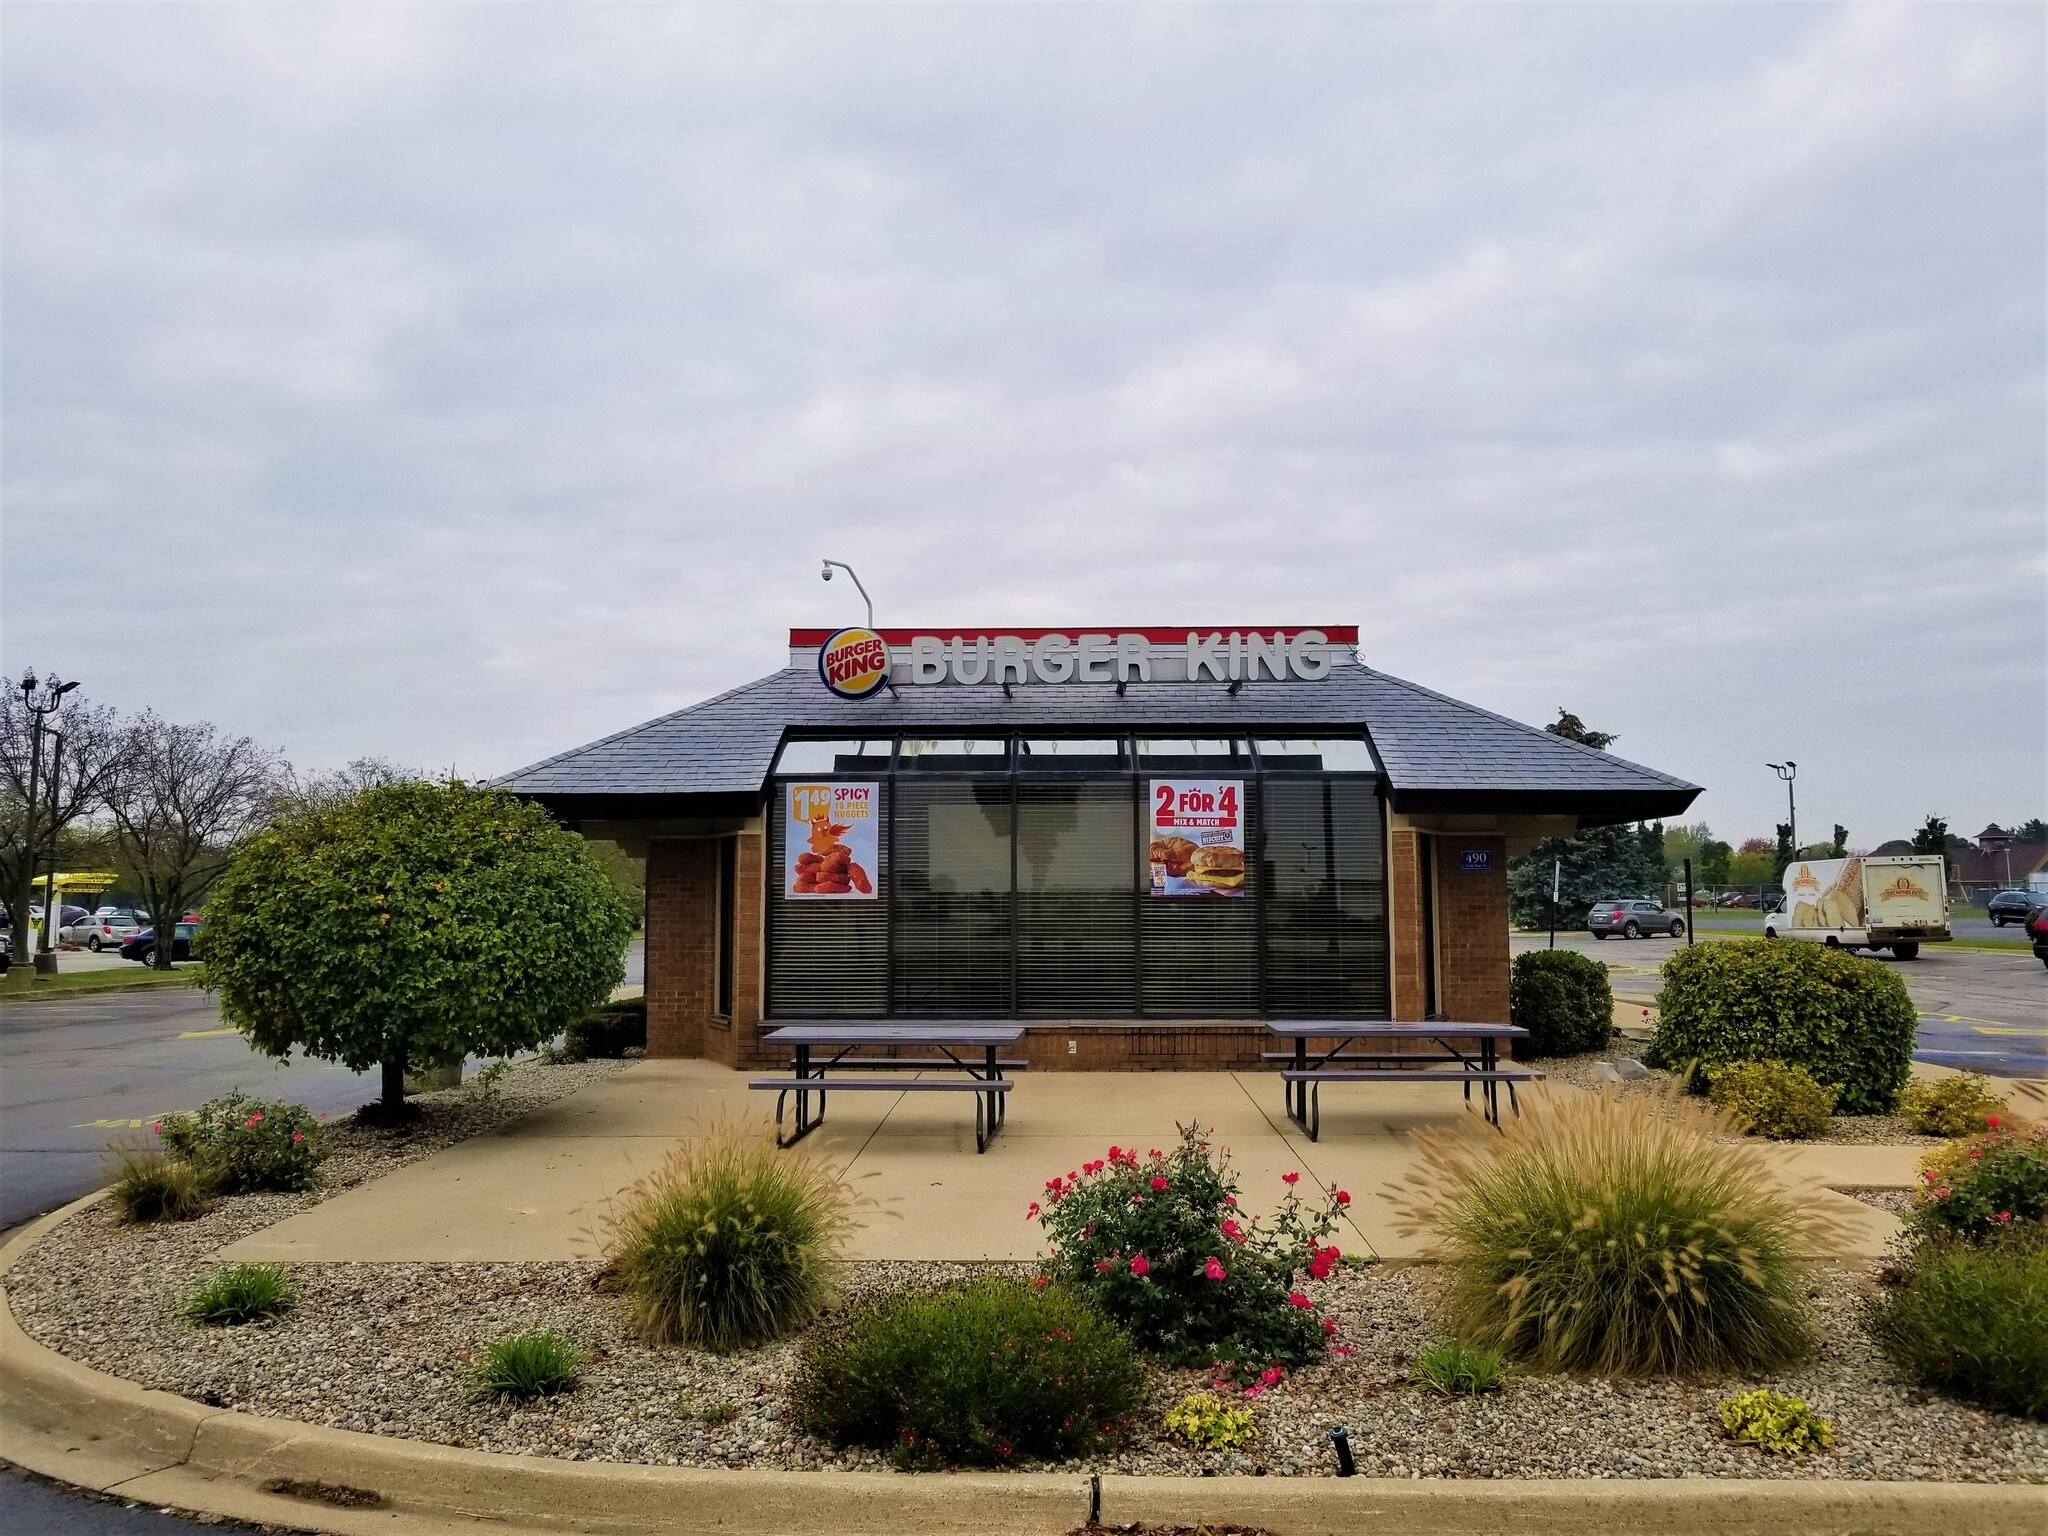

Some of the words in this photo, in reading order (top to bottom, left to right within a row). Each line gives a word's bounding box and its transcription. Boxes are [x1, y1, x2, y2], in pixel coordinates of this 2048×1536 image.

[826, 639, 883, 668] BURGER
[911, 633, 1152, 686] BURGER
[1185, 630, 1332, 683] KING
[829, 651, 886, 686] KING
[834, 788, 870, 801] SPICY
[1156, 785, 1175, 817] 2
[1179, 792, 1215, 812] FOR
[1218, 786, 1239, 818] $4
[834, 810, 869, 818] NUGGETS
[1174, 818, 1187, 826] MIX
[1188, 818, 1195, 826] &
[1196, 818, 1220, 826] MATCH
[1465, 852, 1487, 863] 490
